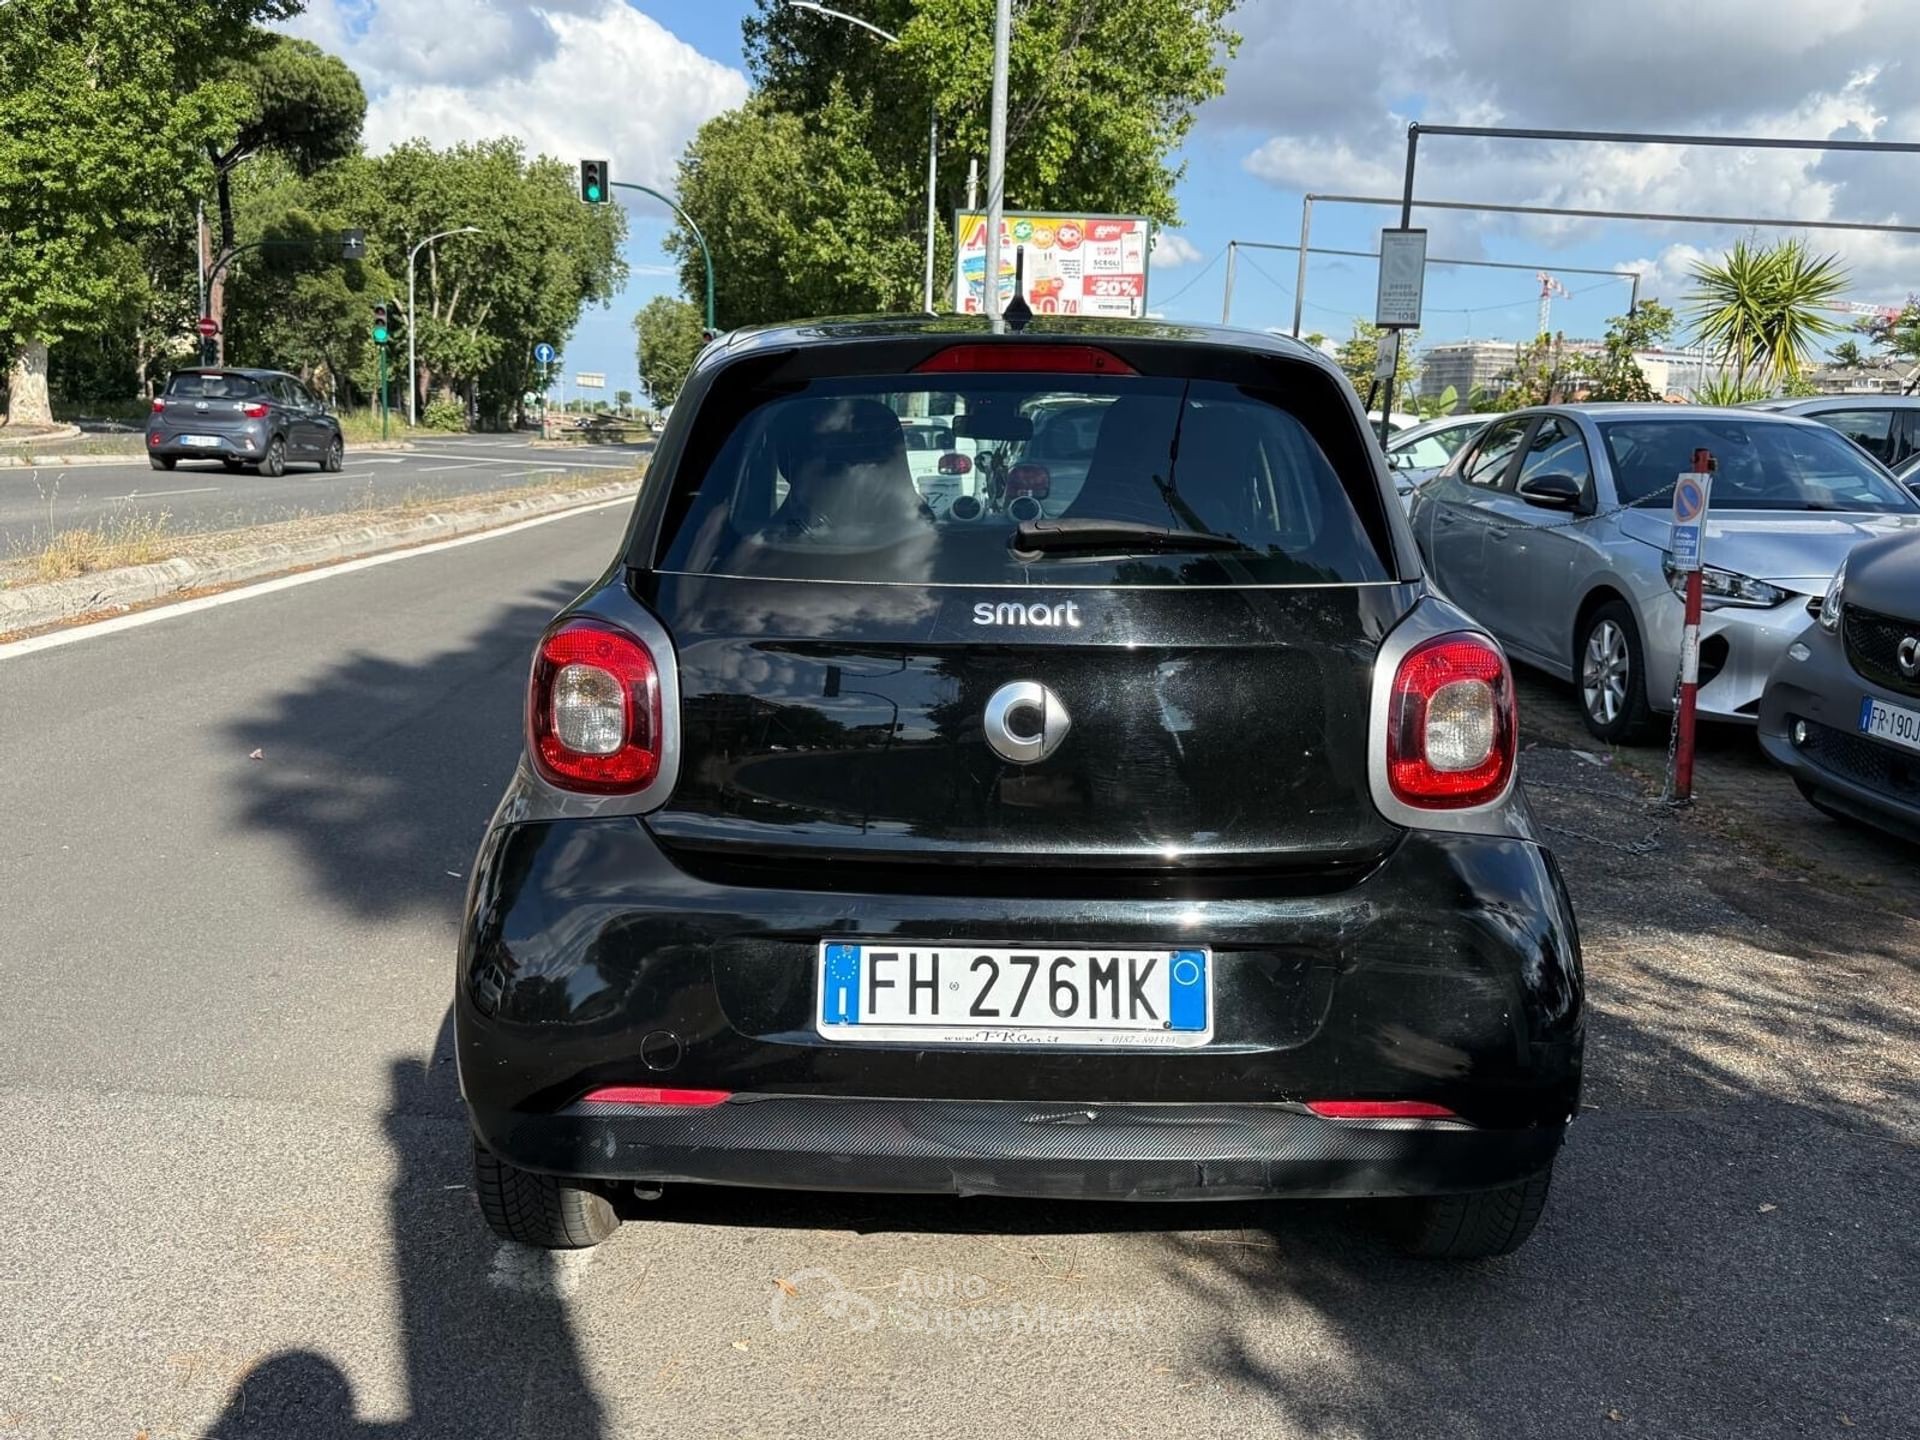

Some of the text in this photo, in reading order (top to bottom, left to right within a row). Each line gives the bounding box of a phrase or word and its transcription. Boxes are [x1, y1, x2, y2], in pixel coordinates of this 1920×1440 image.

[972, 600, 1082, 627] smart
[1869, 707, 1887, 731] FR
[1890, 713, 1920, 742] 190J
[868, 952, 940, 1015] FH
[968, 954, 1159, 1021] 276MK
